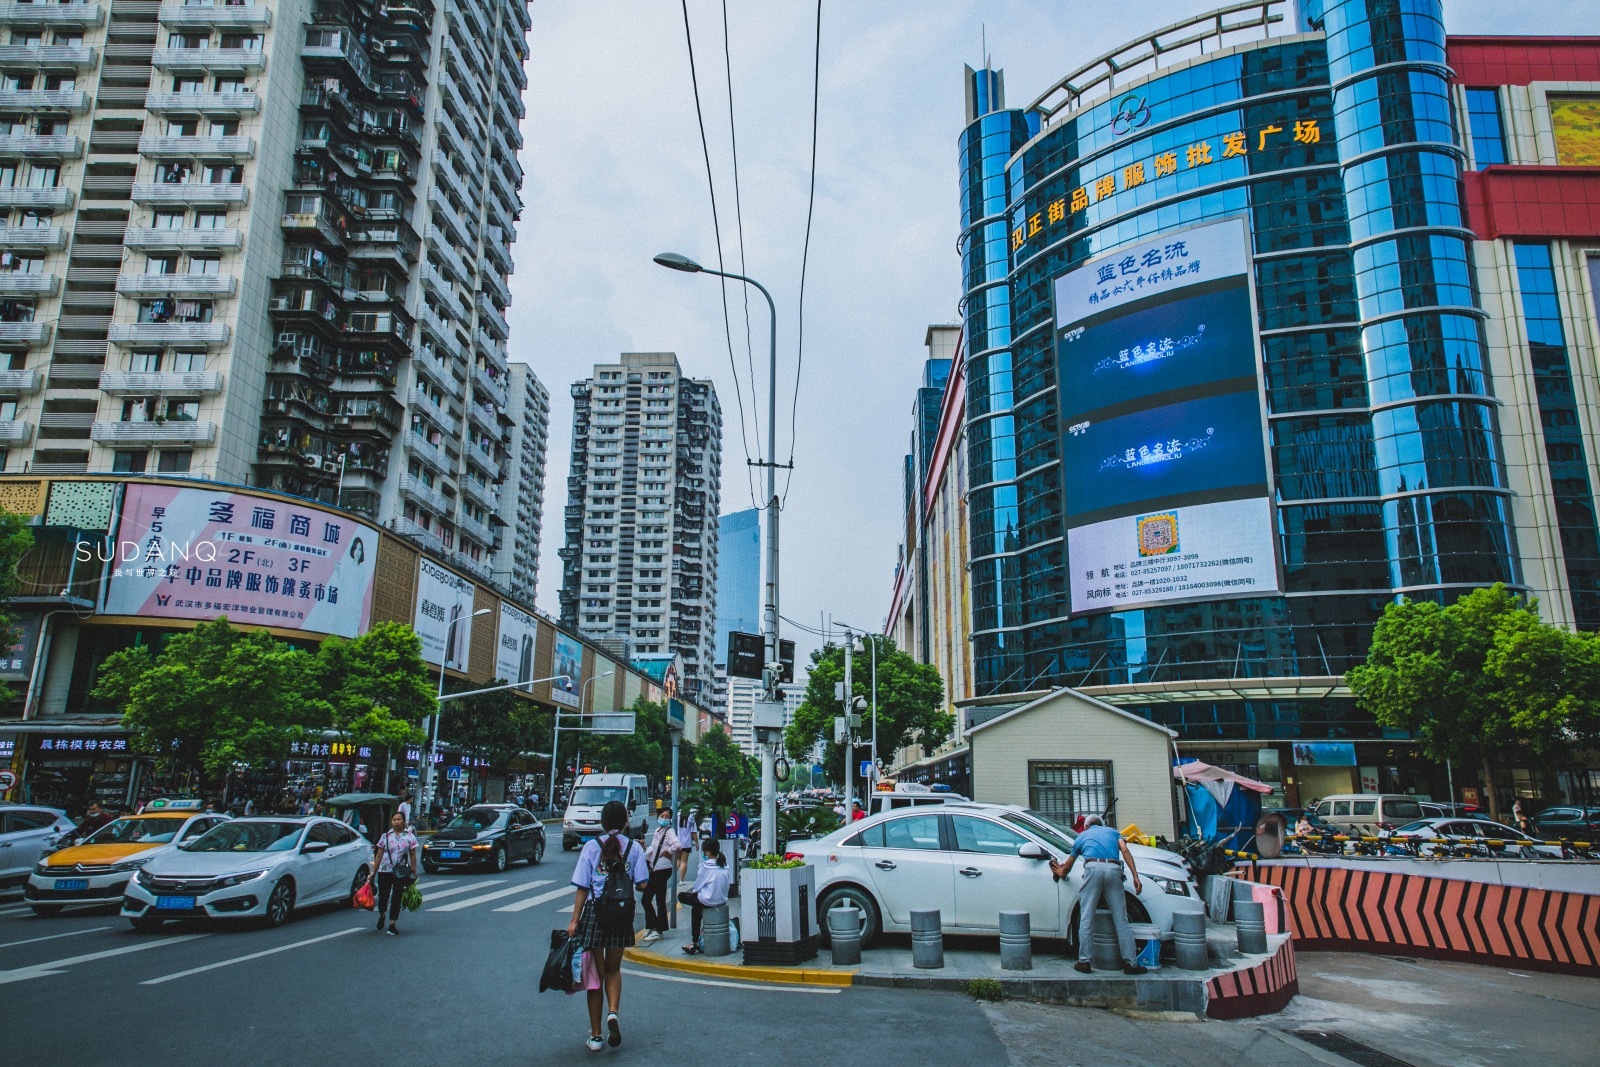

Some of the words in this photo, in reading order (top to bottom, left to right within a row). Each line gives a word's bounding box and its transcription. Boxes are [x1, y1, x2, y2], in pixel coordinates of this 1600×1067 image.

[1012, 120, 1320, 251] 汉正街品牌服饰批发广场
[1096, 241, 1189, 285] 蓝色名流
[1119, 337, 1175, 361] 蓝色名流
[1125, 438, 1181, 462] 蓝色名流
[208, 501, 341, 544] 多福商城
[288, 557, 311, 574] 3F
[165, 563, 340, 605] 华中品牌服饰跳蚤市场
[175, 599, 304, 620] 武汉市多福宏洋物业管理有限公司
